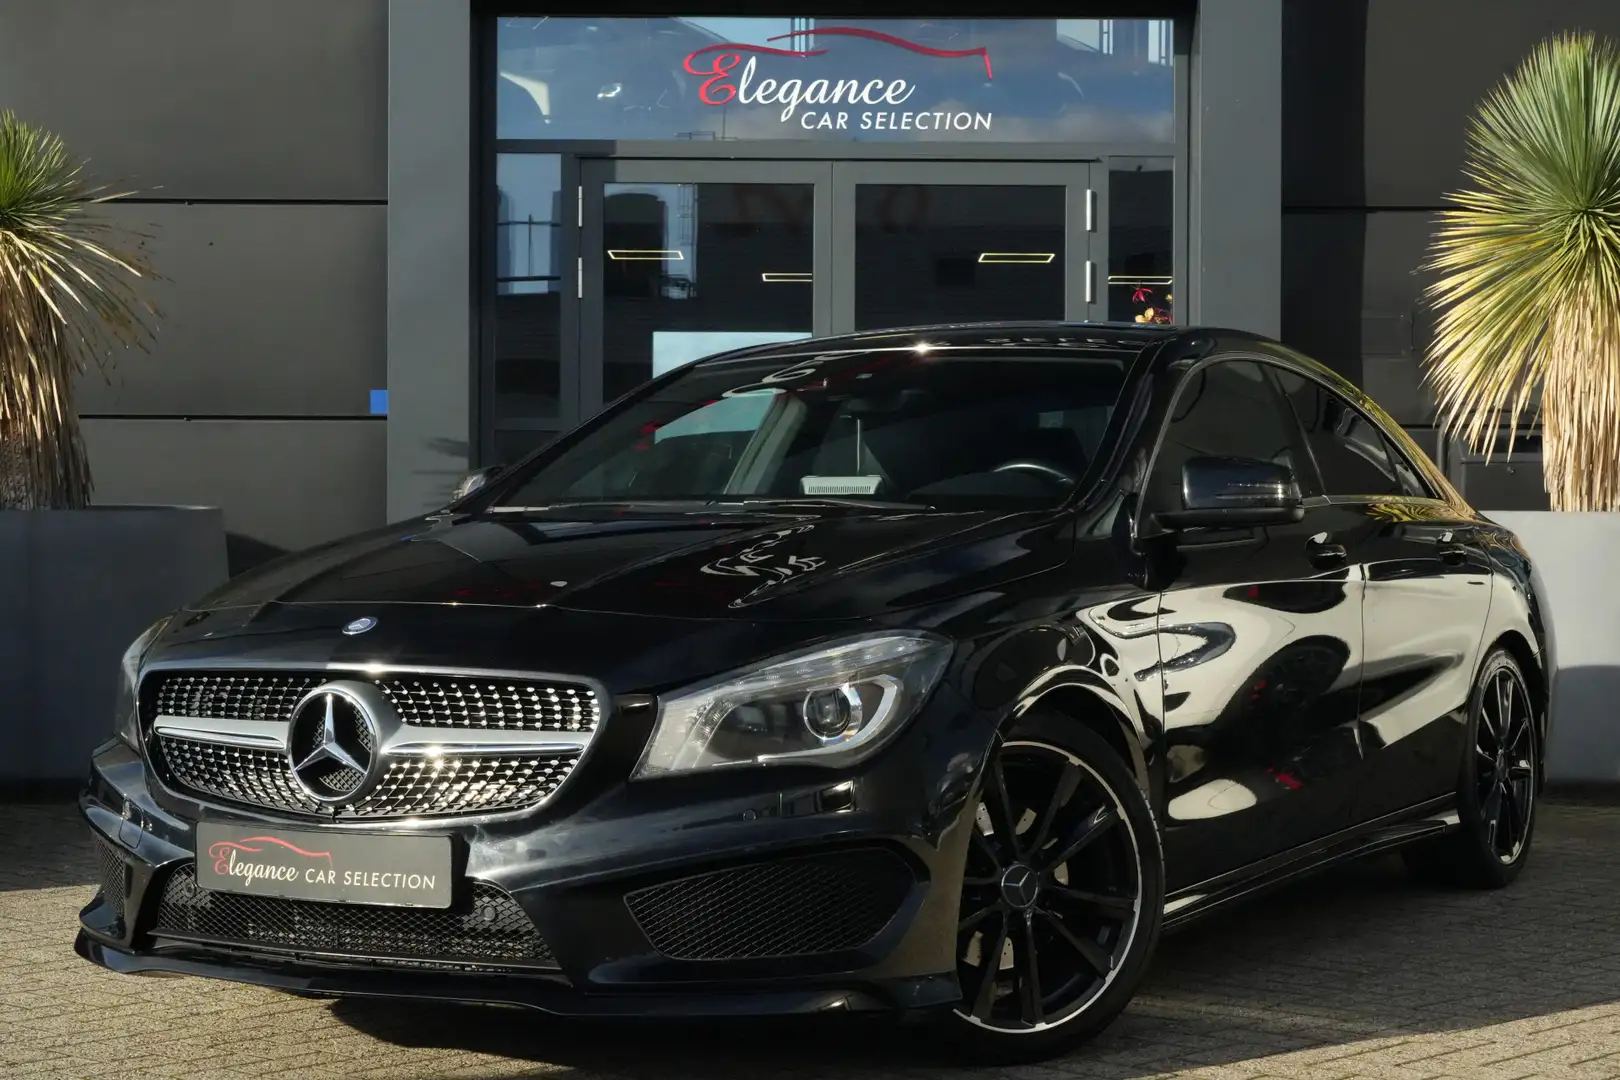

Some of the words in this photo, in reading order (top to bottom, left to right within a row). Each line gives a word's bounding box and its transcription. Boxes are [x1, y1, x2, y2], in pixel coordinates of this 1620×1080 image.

[683, 53, 916, 122] Elegance
[801, 111, 848, 130] CAR
[859, 112, 992, 130] SELECTION
[209, 846, 299, 886] Elegance
[305, 868, 336, 885] CAR
[343, 871, 435, 889] SELECTION
